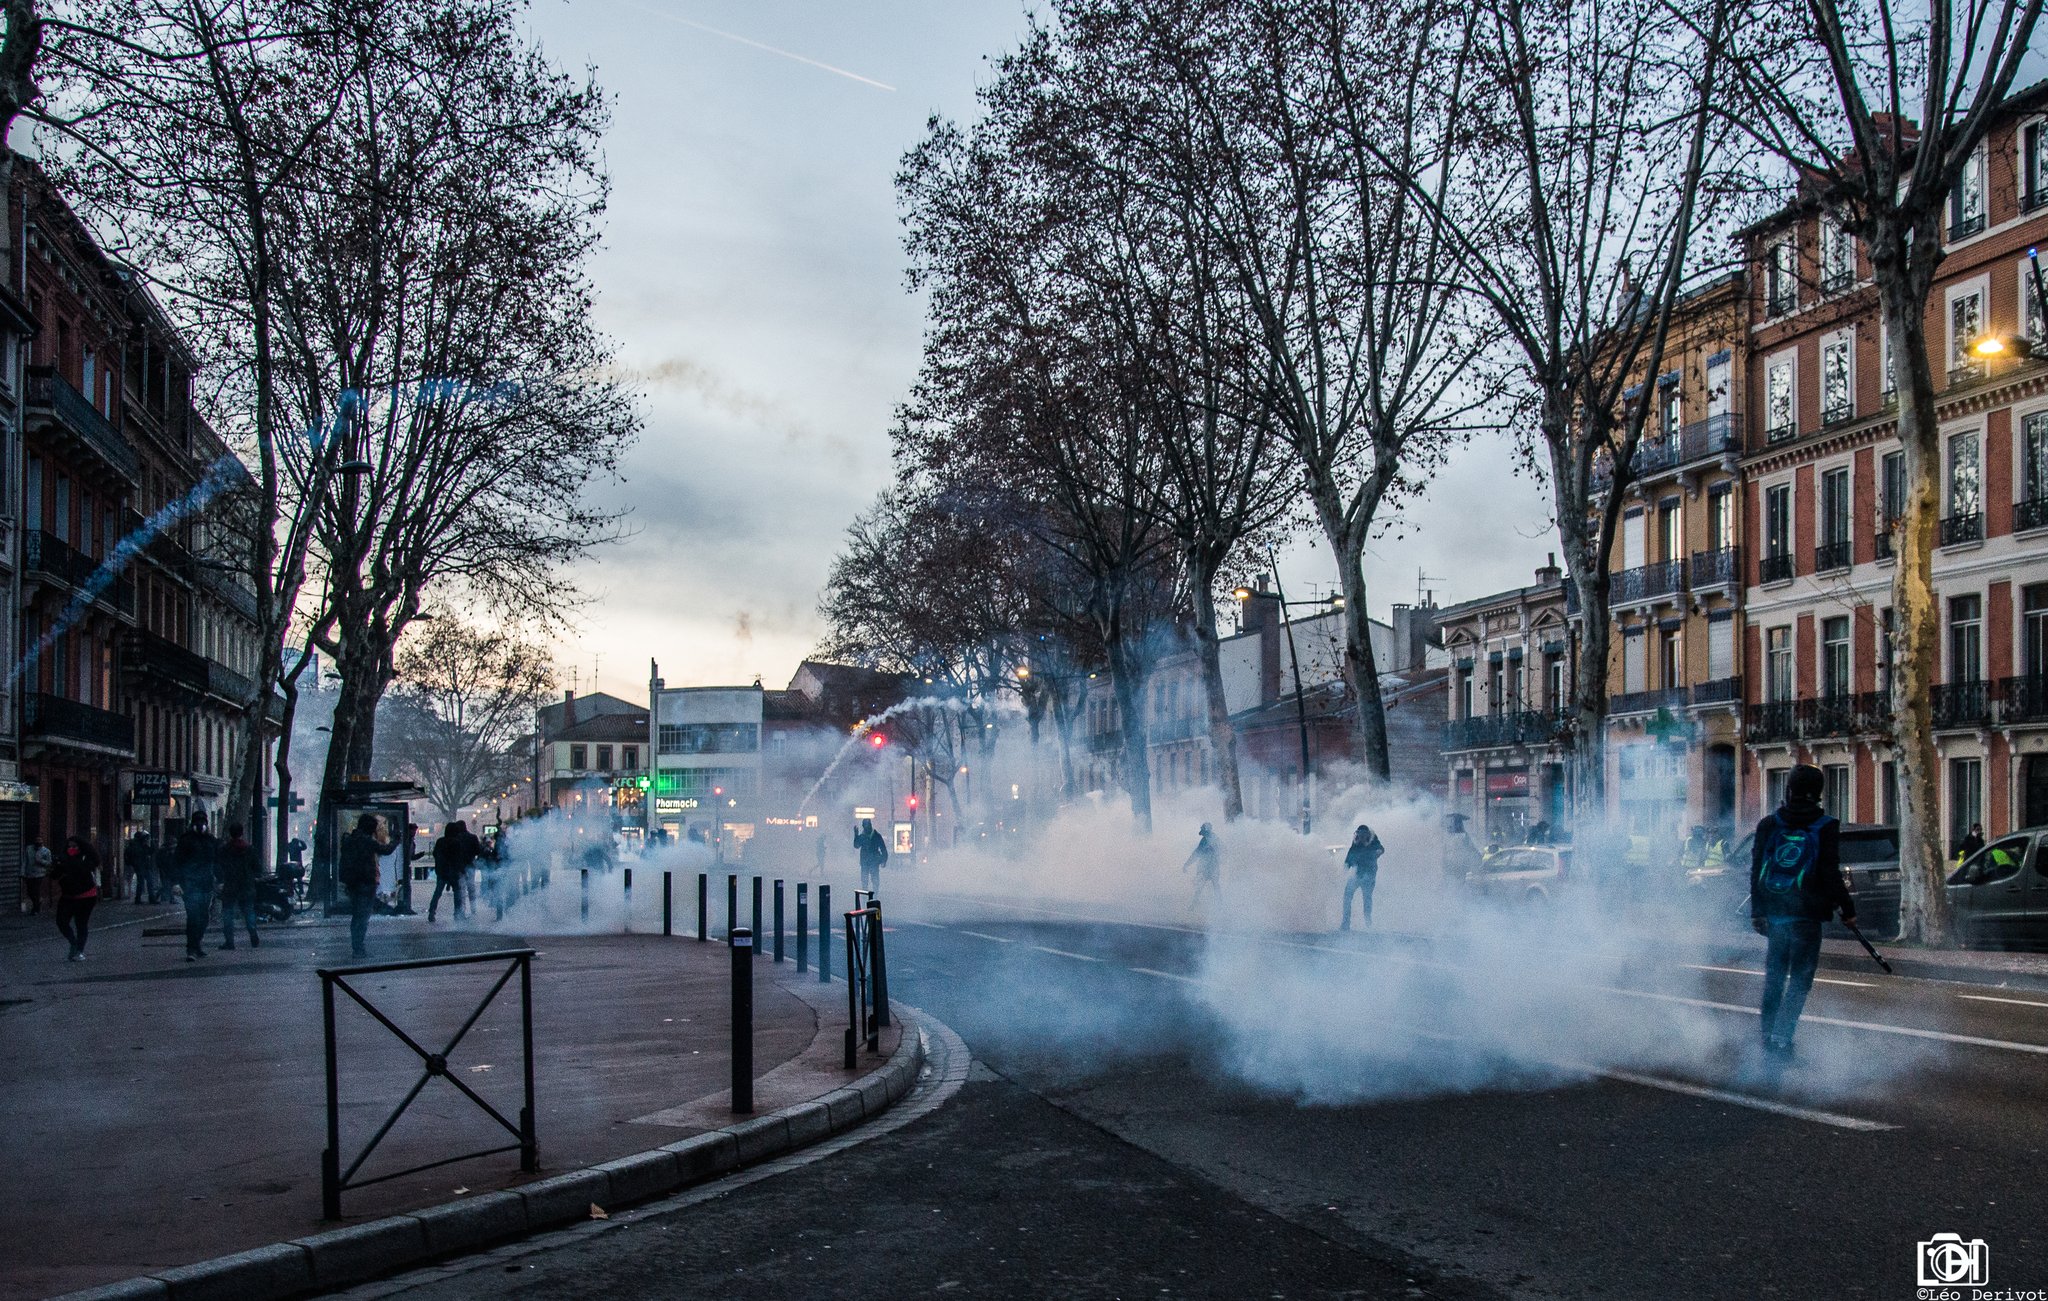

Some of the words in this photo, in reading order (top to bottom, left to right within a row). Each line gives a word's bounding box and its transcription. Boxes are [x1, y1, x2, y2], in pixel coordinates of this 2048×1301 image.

[136, 774, 168, 784] PIZZA
[613, 777, 635, 788] KFC
[655, 798, 698, 808] Pharmacie
[766, 817, 789, 825] Max
